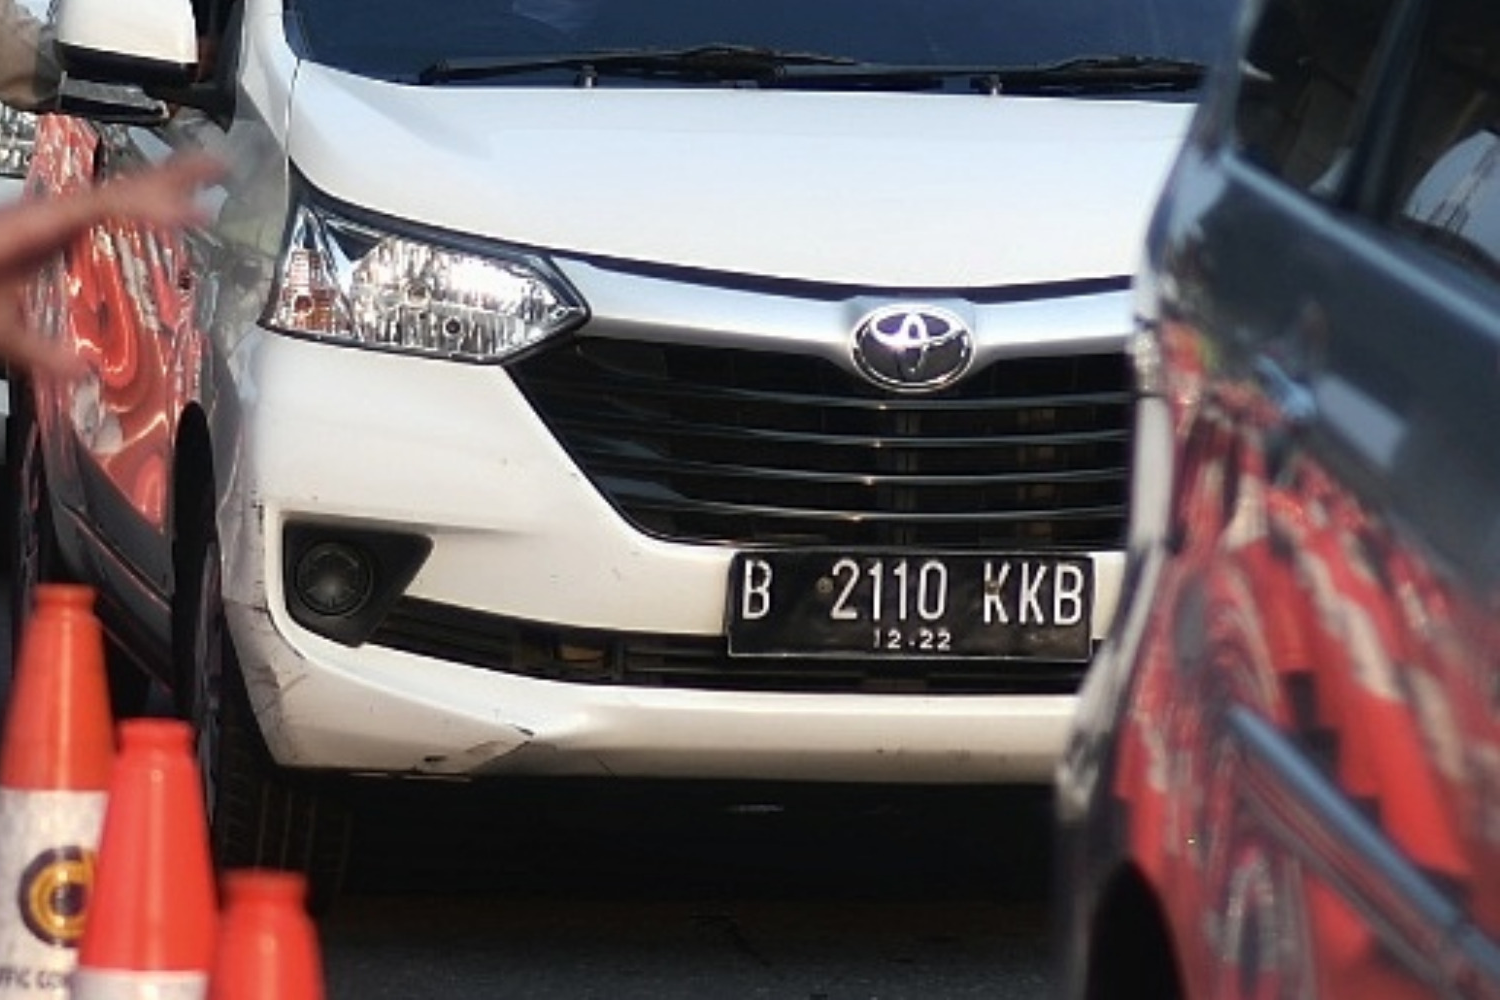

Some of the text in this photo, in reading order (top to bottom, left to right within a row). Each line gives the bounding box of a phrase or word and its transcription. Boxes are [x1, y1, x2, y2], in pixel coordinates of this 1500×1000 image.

[742, 558, 1085, 625] B 2110 KKB
[872, 626, 952, 652] 12.22
